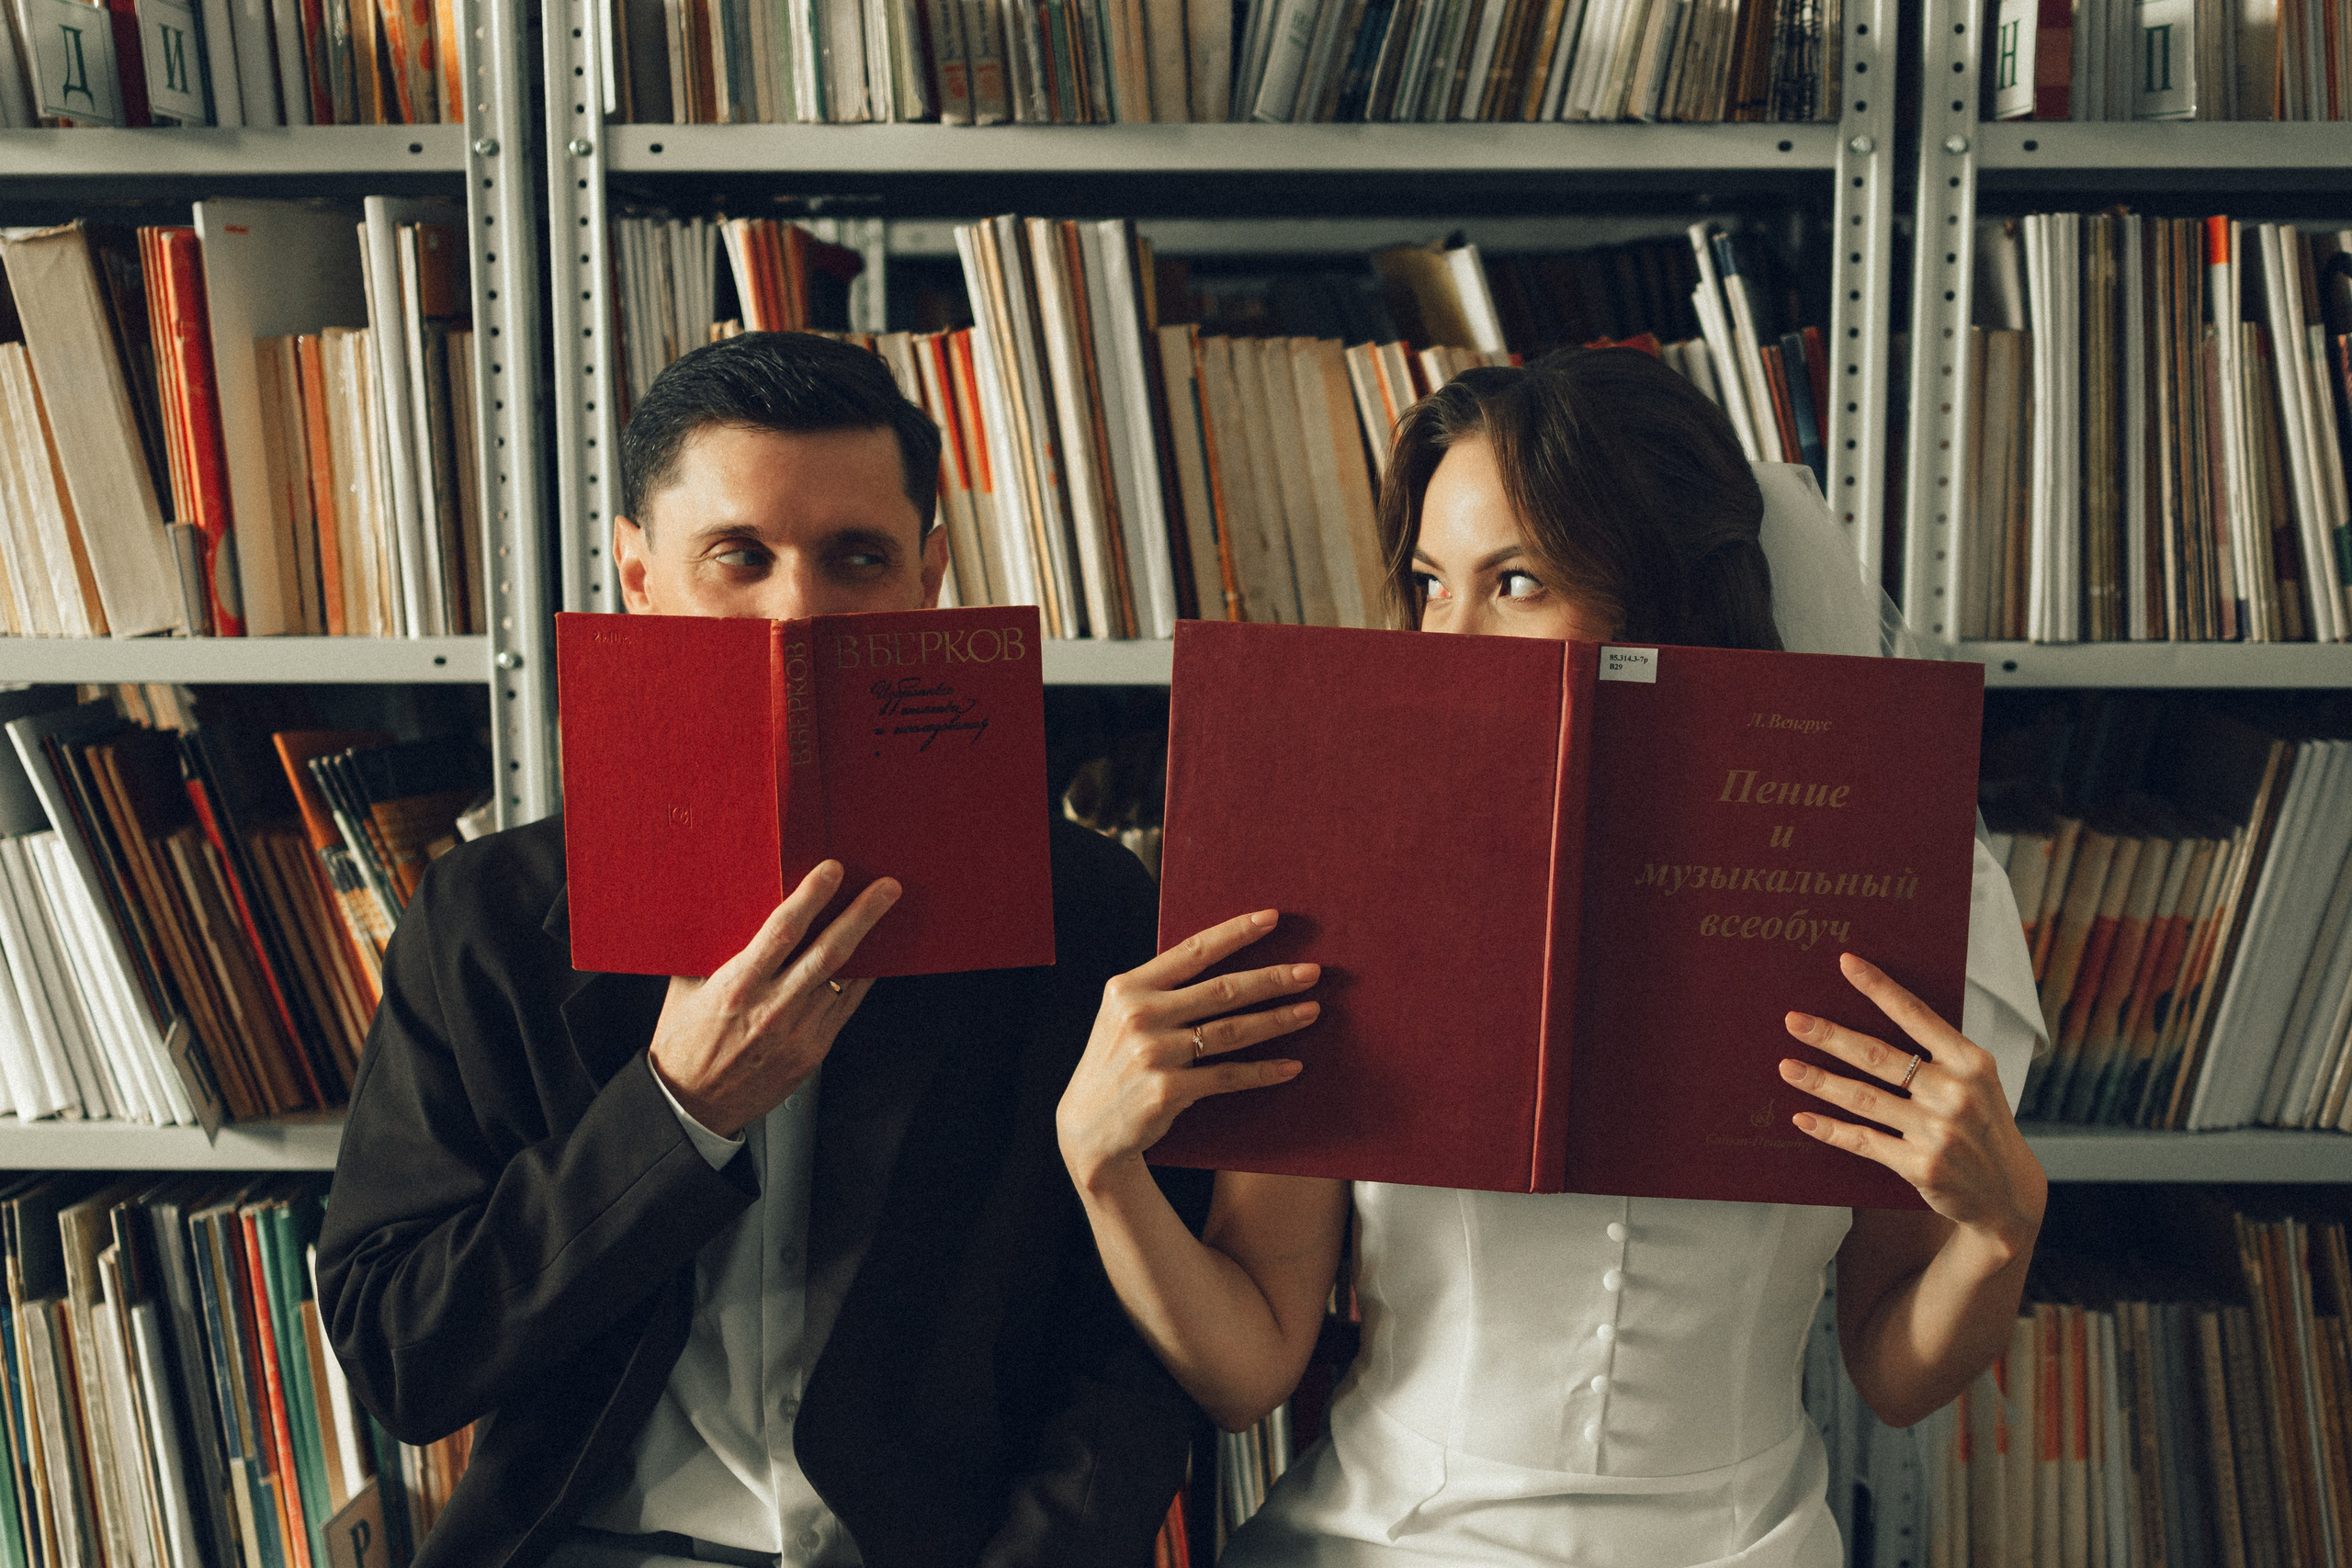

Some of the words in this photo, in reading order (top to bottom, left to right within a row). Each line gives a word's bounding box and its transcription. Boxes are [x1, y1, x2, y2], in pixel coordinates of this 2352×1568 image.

[58, 23, 96, 112] Д
[158, 22, 190, 95] И
[1997, 18, 2020, 91] Н
[2143, 23, 2174, 93] П
[866, 626, 1027, 668] БЕРКОВ
[1770, 714, 1834, 734] Венгрус
[1716, 769, 1851, 808] Пение
[1770, 825, 1794, 849] и
[1634, 862, 1919, 900] музыкальный
[1700, 908, 1851, 951] всеобуч
